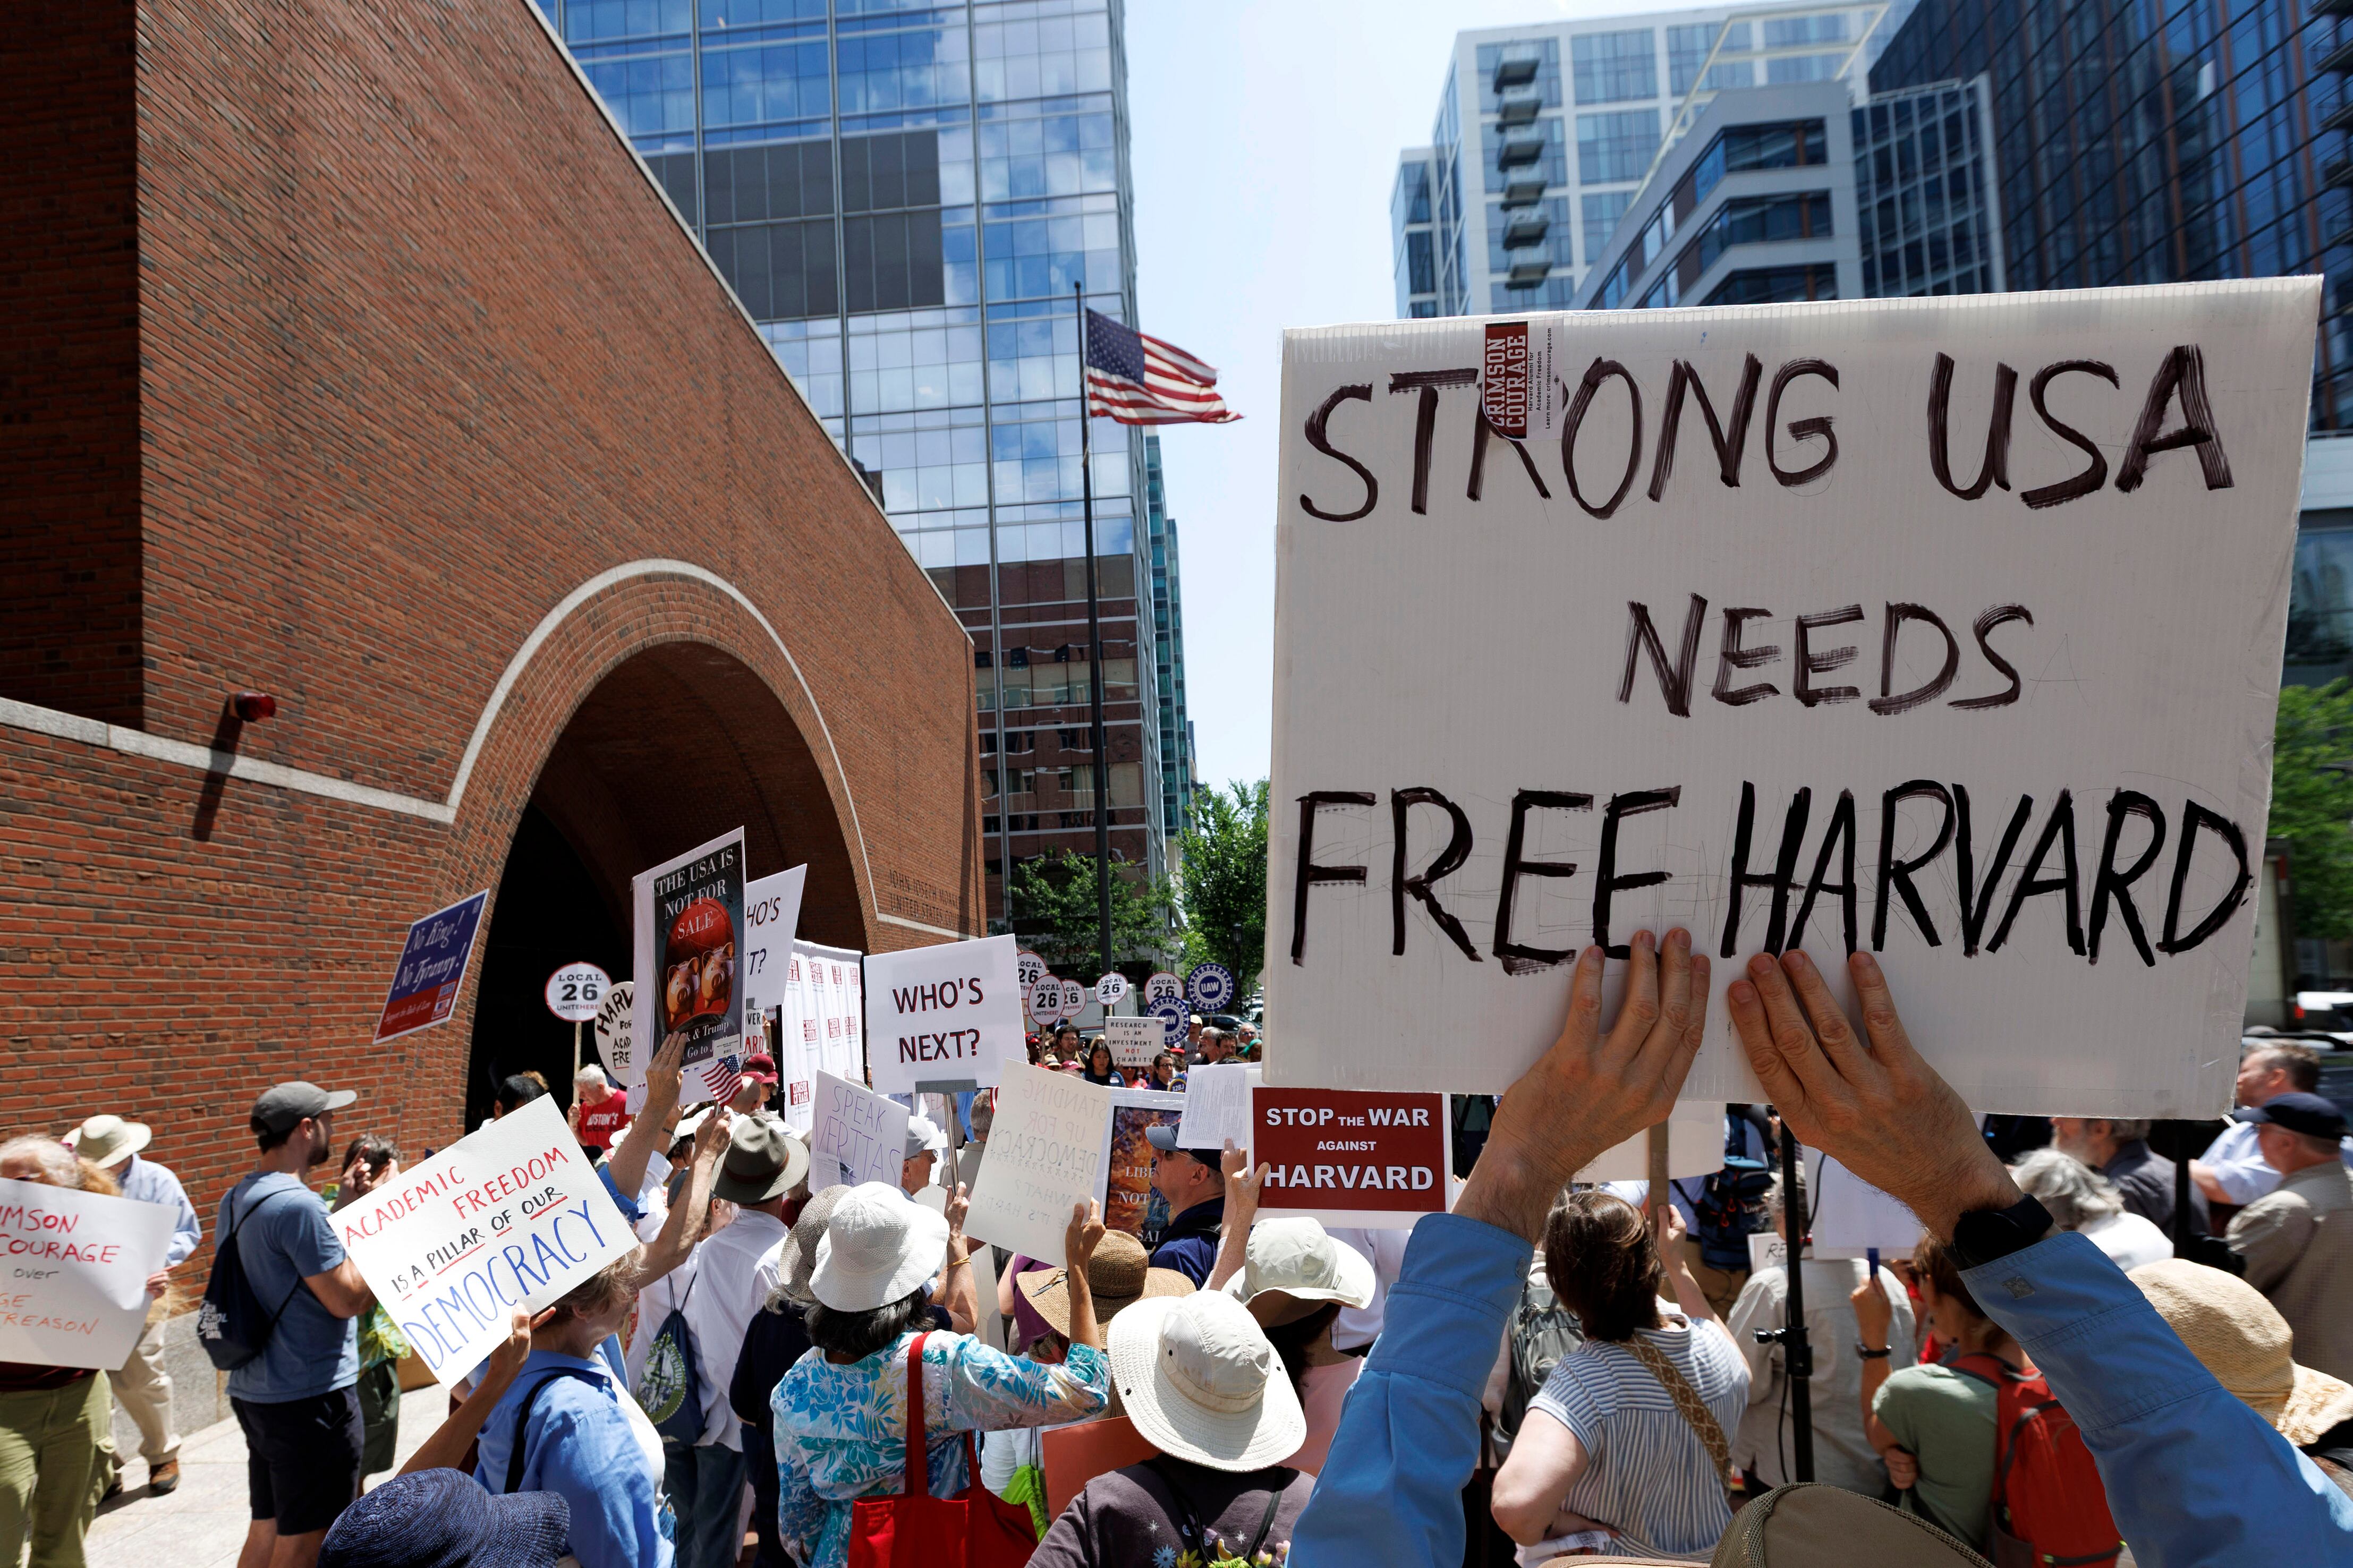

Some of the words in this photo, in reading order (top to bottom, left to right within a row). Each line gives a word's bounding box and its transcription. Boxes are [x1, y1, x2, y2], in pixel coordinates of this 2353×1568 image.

[1486, 339, 1506, 427] CRIMSON
[1506, 335, 1526, 428] COURAGE
[1927, 344, 2235, 509] USA
[1616, 593, 2034, 717] NEEDS
[657, 871, 685, 896] THE
[689, 857, 717, 882] USA
[720, 849, 733, 869] IS
[889, 869, 910, 892] JOHN
[1292, 785, 1681, 976] FREE
[1721, 778, 2253, 967] HARVARD
[665, 893, 693, 919] NOT
[697, 879, 727, 906] FOR
[406, 927, 425, 955] No
[425, 910, 465, 948] King!
[678, 911, 713, 939] SALE
[395, 962, 414, 991] No
[412, 941, 467, 992] Tyranny!
[746, 948, 767, 975] T?
[1019, 969, 1039, 983] 26
[1102, 984, 1120, 995] 26
[1201, 982, 1220, 993] UAW
[562, 984, 598, 1001] 26
[892, 977, 984, 1014] WHO'S
[1037, 993, 1057, 1008] 26
[1153, 986, 1175, 998] 26
[702, 1021, 729, 1036] Trump
[745, 1012, 761, 1025] VER
[1159, 1015, 1177, 1025] AW
[612, 1051, 631, 1067] FRE
[687, 1046, 699, 1058] Go
[700, 1045, 709, 1054] to
[898, 1028, 980, 1063] NEXT?
[832, 1086, 886, 1133] SPEAK
[1266, 1108, 1334, 1126] STOP
[1338, 1117, 1365, 1126] THE
[1368, 1108, 1430, 1126] WAR
[1317, 1141, 1377, 1151] AGAINST
[453, 1147, 570, 1220] FREEDOM
[1263, 1164, 1433, 1190] HARVARD
[345, 1166, 465, 1247] ACADEMIC
[1118, 1192, 1151, 1205] NOT
[392, 1277, 409, 1294] IS
[411, 1265, 424, 1281] A
[426, 1228, 485, 1269] PILLAR
[490, 1209, 513, 1231] OF
[521, 1186, 563, 1215] OUR
[13, 1268, 59, 1280] over
[402, 1199, 606, 1370] DEMOCRACY
